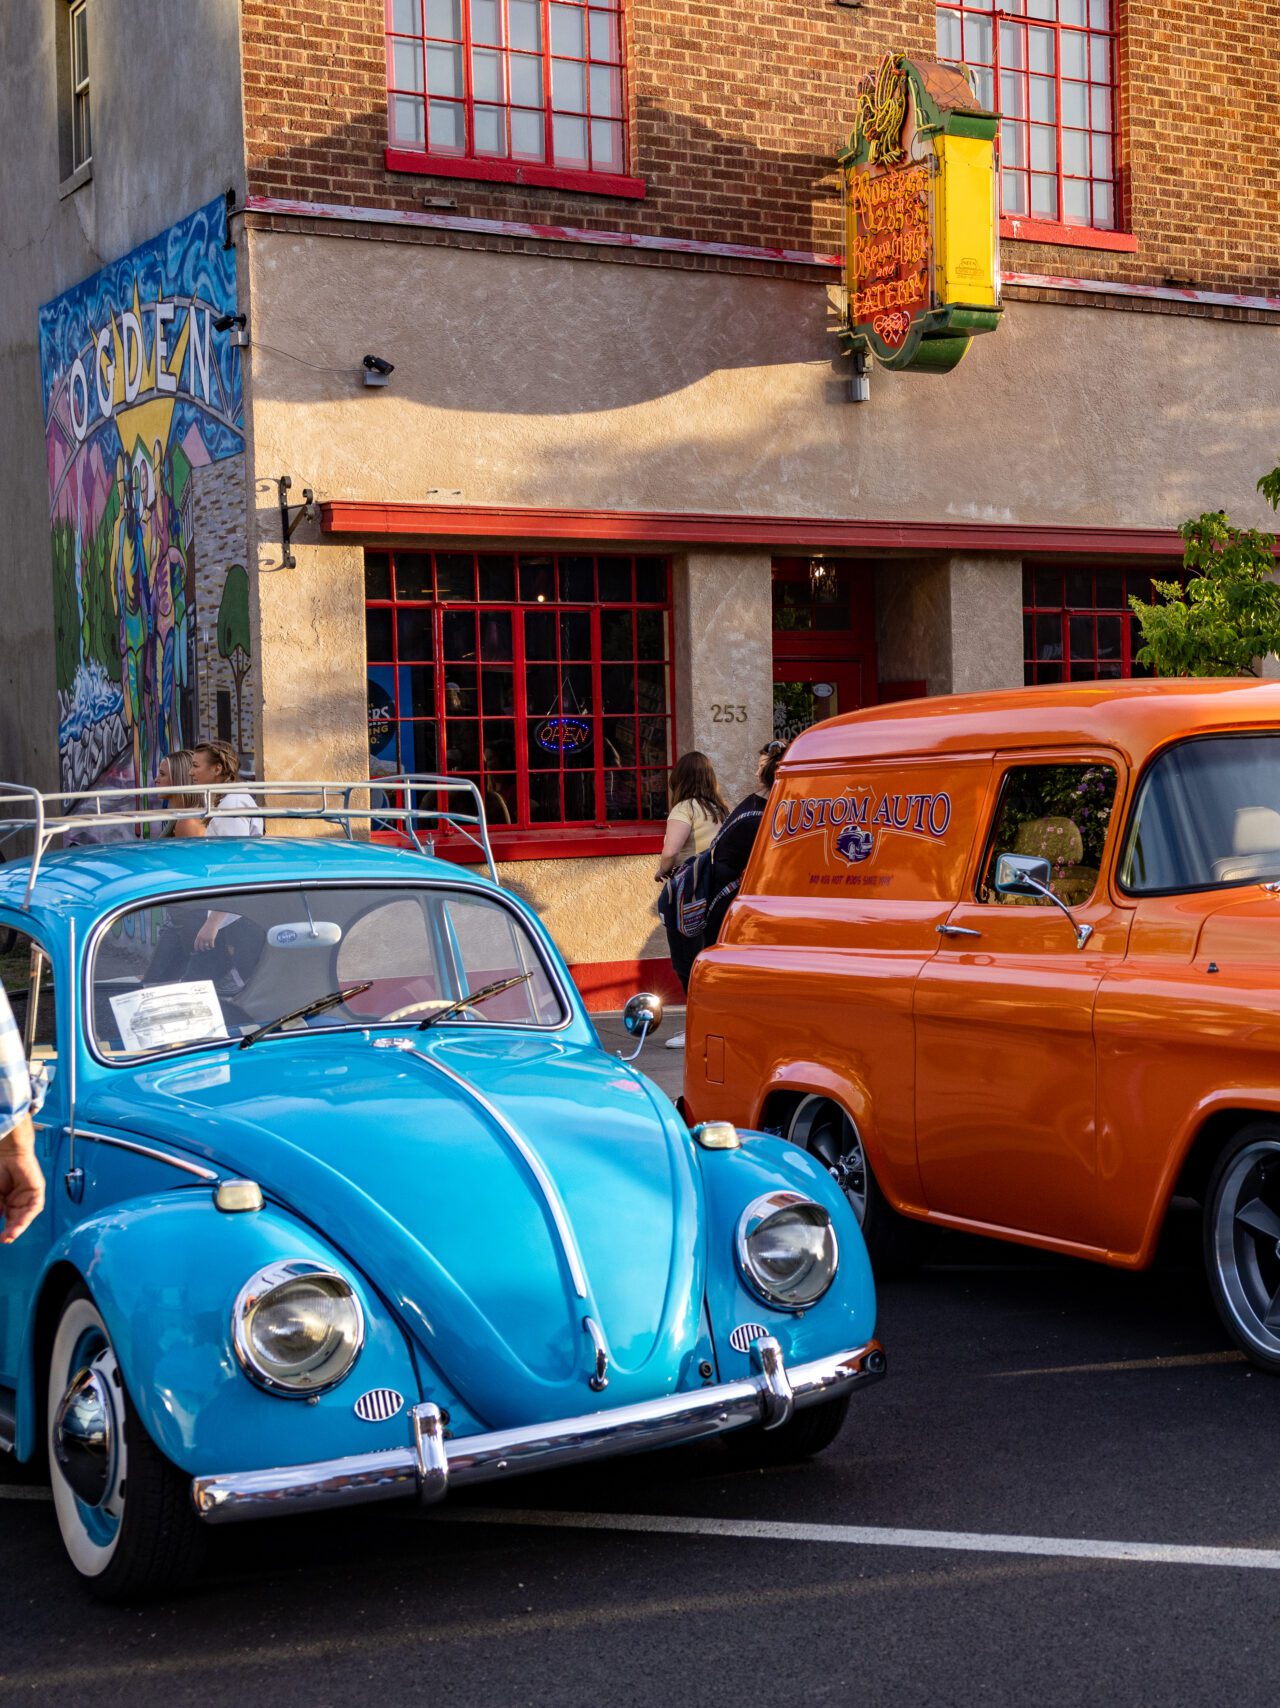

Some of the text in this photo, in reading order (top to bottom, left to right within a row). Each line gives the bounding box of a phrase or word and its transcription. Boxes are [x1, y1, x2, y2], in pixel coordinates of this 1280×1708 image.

[875, 261, 899, 277] and
[851, 271, 927, 317] EATERY
[69, 302, 212, 442] OGDEN
[710, 704, 748, 723] 253
[541, 726, 590, 743] OPEN
[771, 792, 952, 841] CUSTOM AUTO
